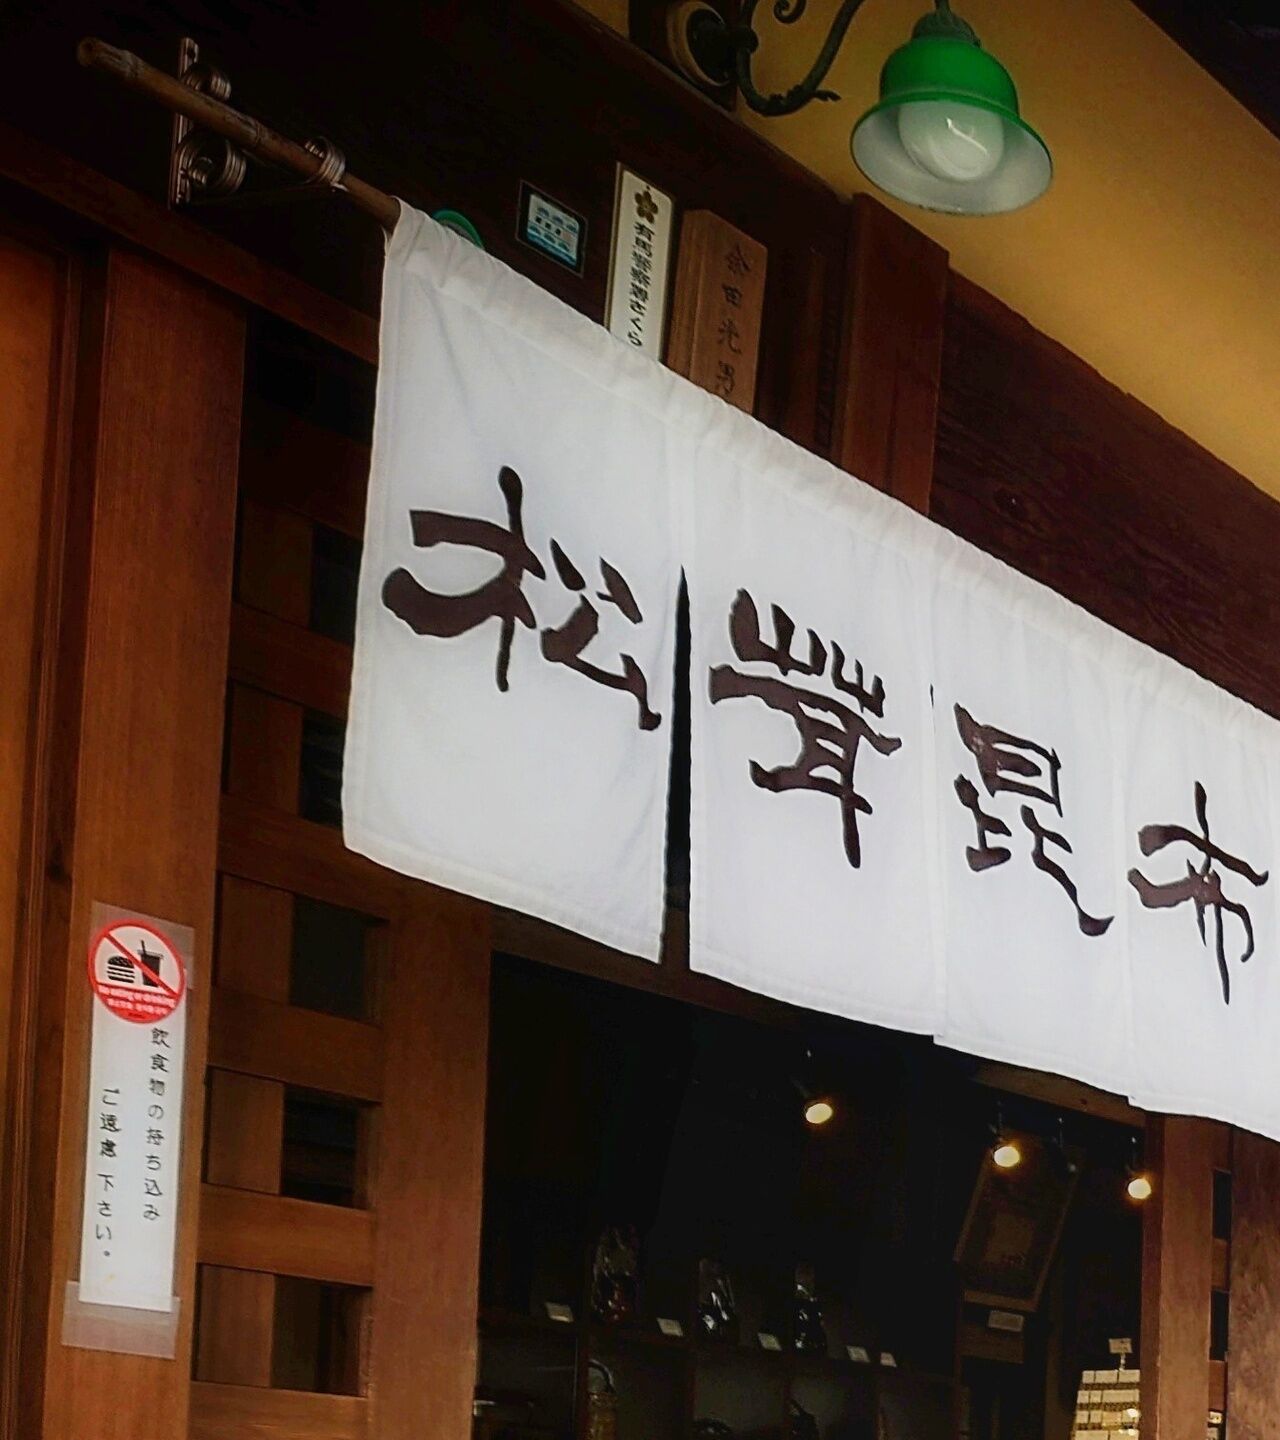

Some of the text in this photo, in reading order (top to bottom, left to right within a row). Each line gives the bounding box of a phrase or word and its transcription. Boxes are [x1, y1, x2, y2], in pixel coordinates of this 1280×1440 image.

[143, 1026, 171, 1221] 飲食物の持ち込み
